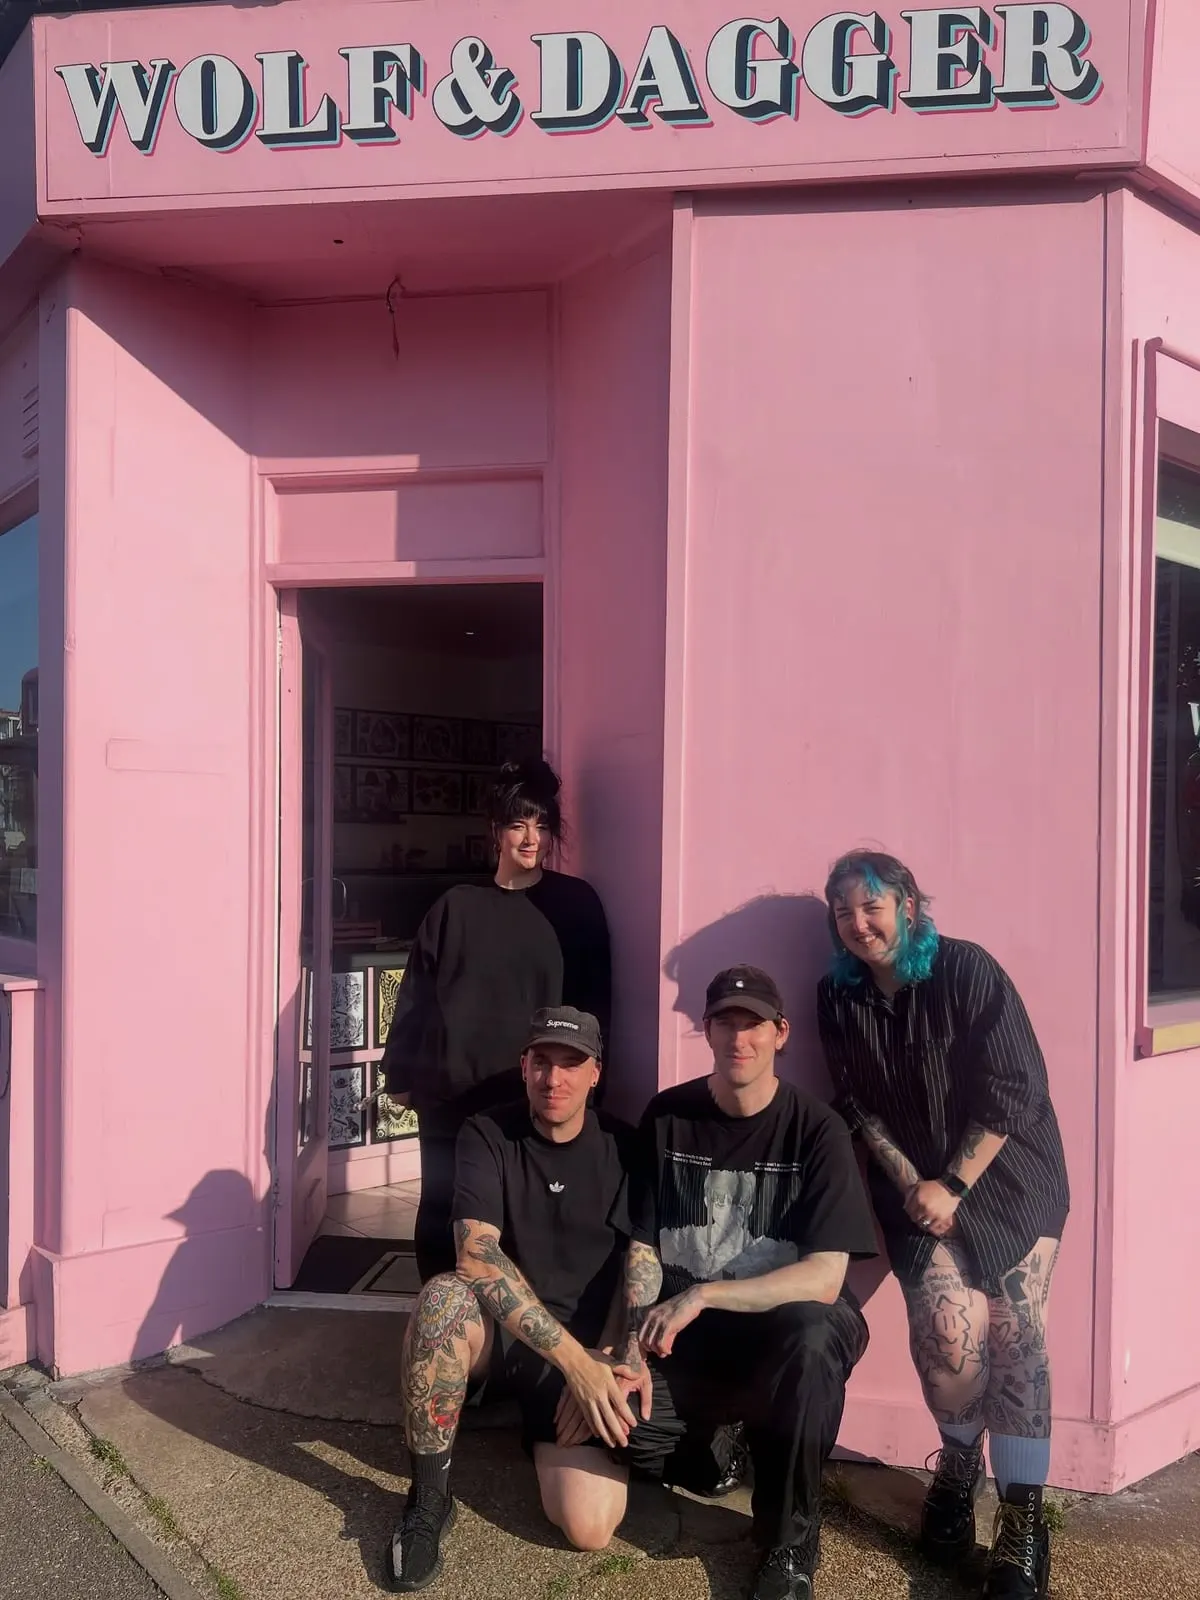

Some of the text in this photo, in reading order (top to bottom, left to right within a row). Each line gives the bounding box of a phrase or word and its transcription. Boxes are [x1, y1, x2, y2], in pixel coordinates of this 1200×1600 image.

[54, 1, 1103, 157] WOLF & DAGGER
[546, 1019, 579, 1031] Supreme
